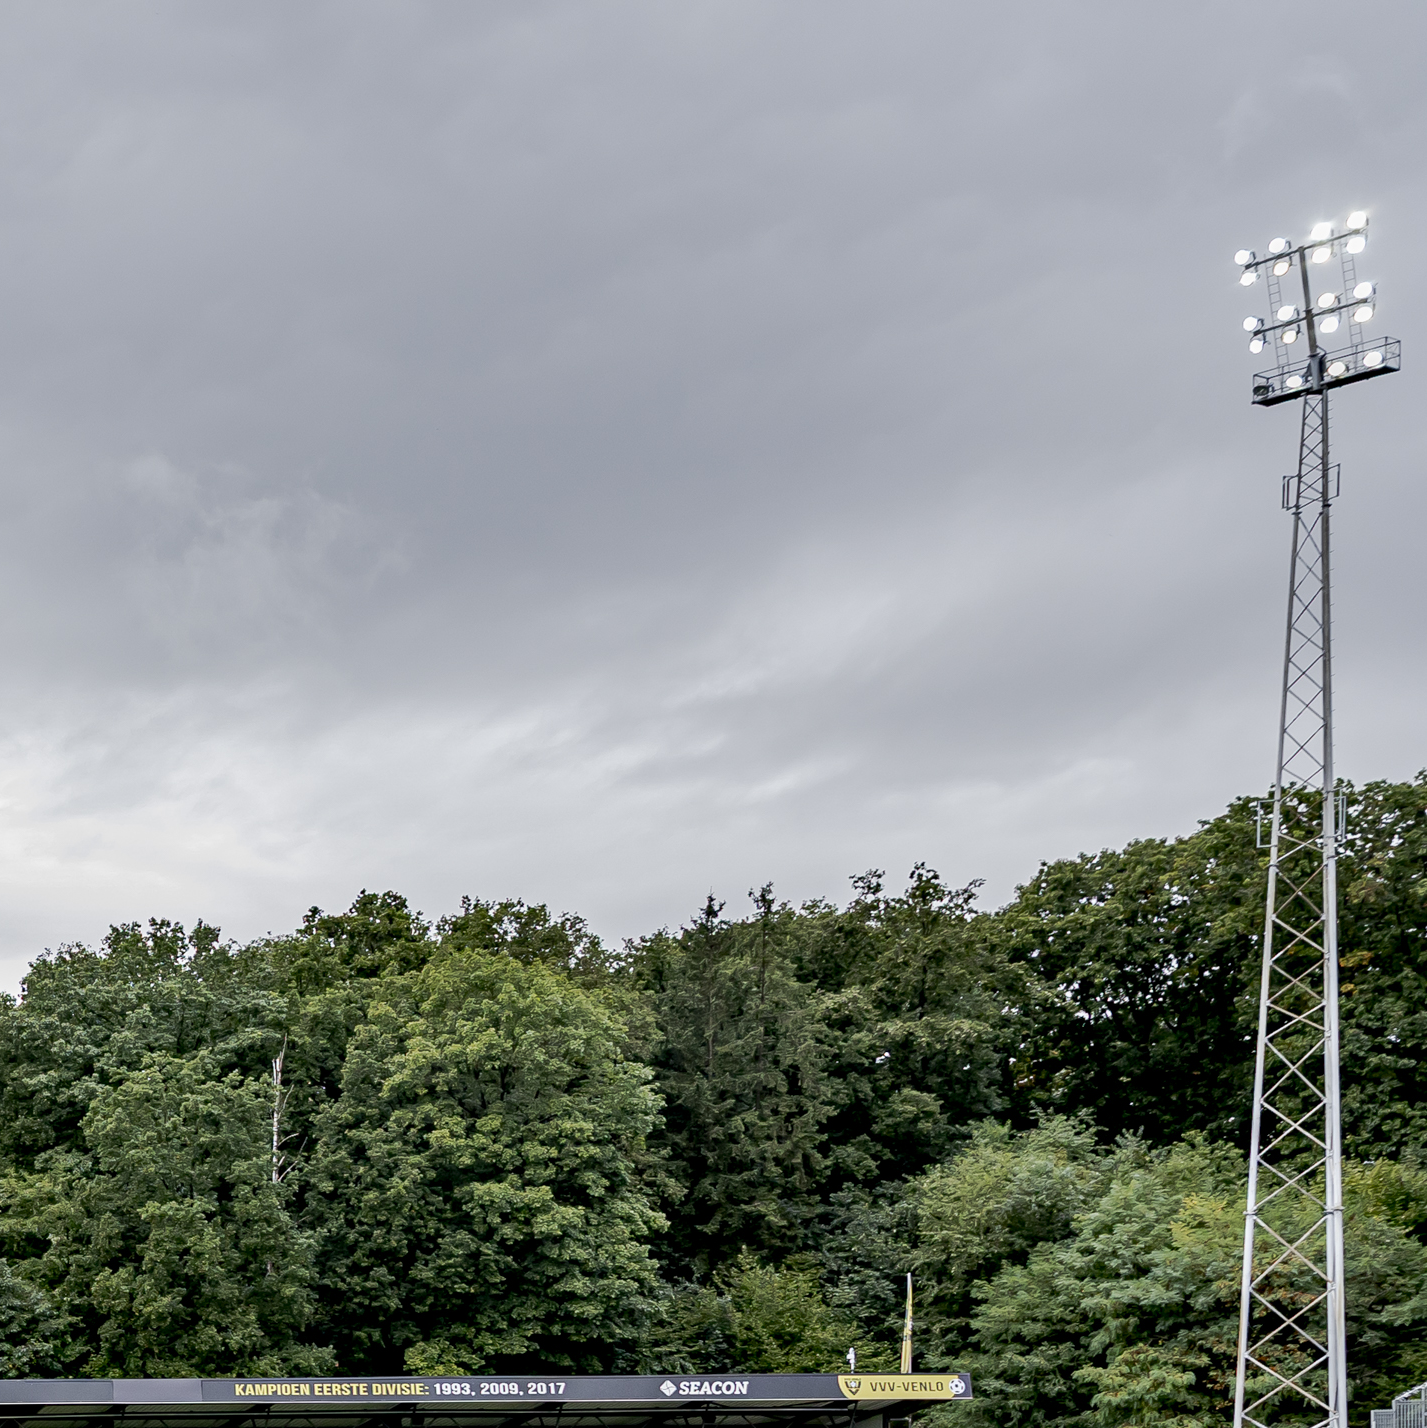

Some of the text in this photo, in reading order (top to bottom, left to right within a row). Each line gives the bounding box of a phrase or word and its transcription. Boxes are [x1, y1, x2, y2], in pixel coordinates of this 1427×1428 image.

[235, 1383, 566, 1397] KAMPIOEN EERSTE DIVISIE: 1993, 2009, 2017
[678, 1381, 749, 1395] SEACON
[870, 1381, 944, 1392] VVV-VENLO
